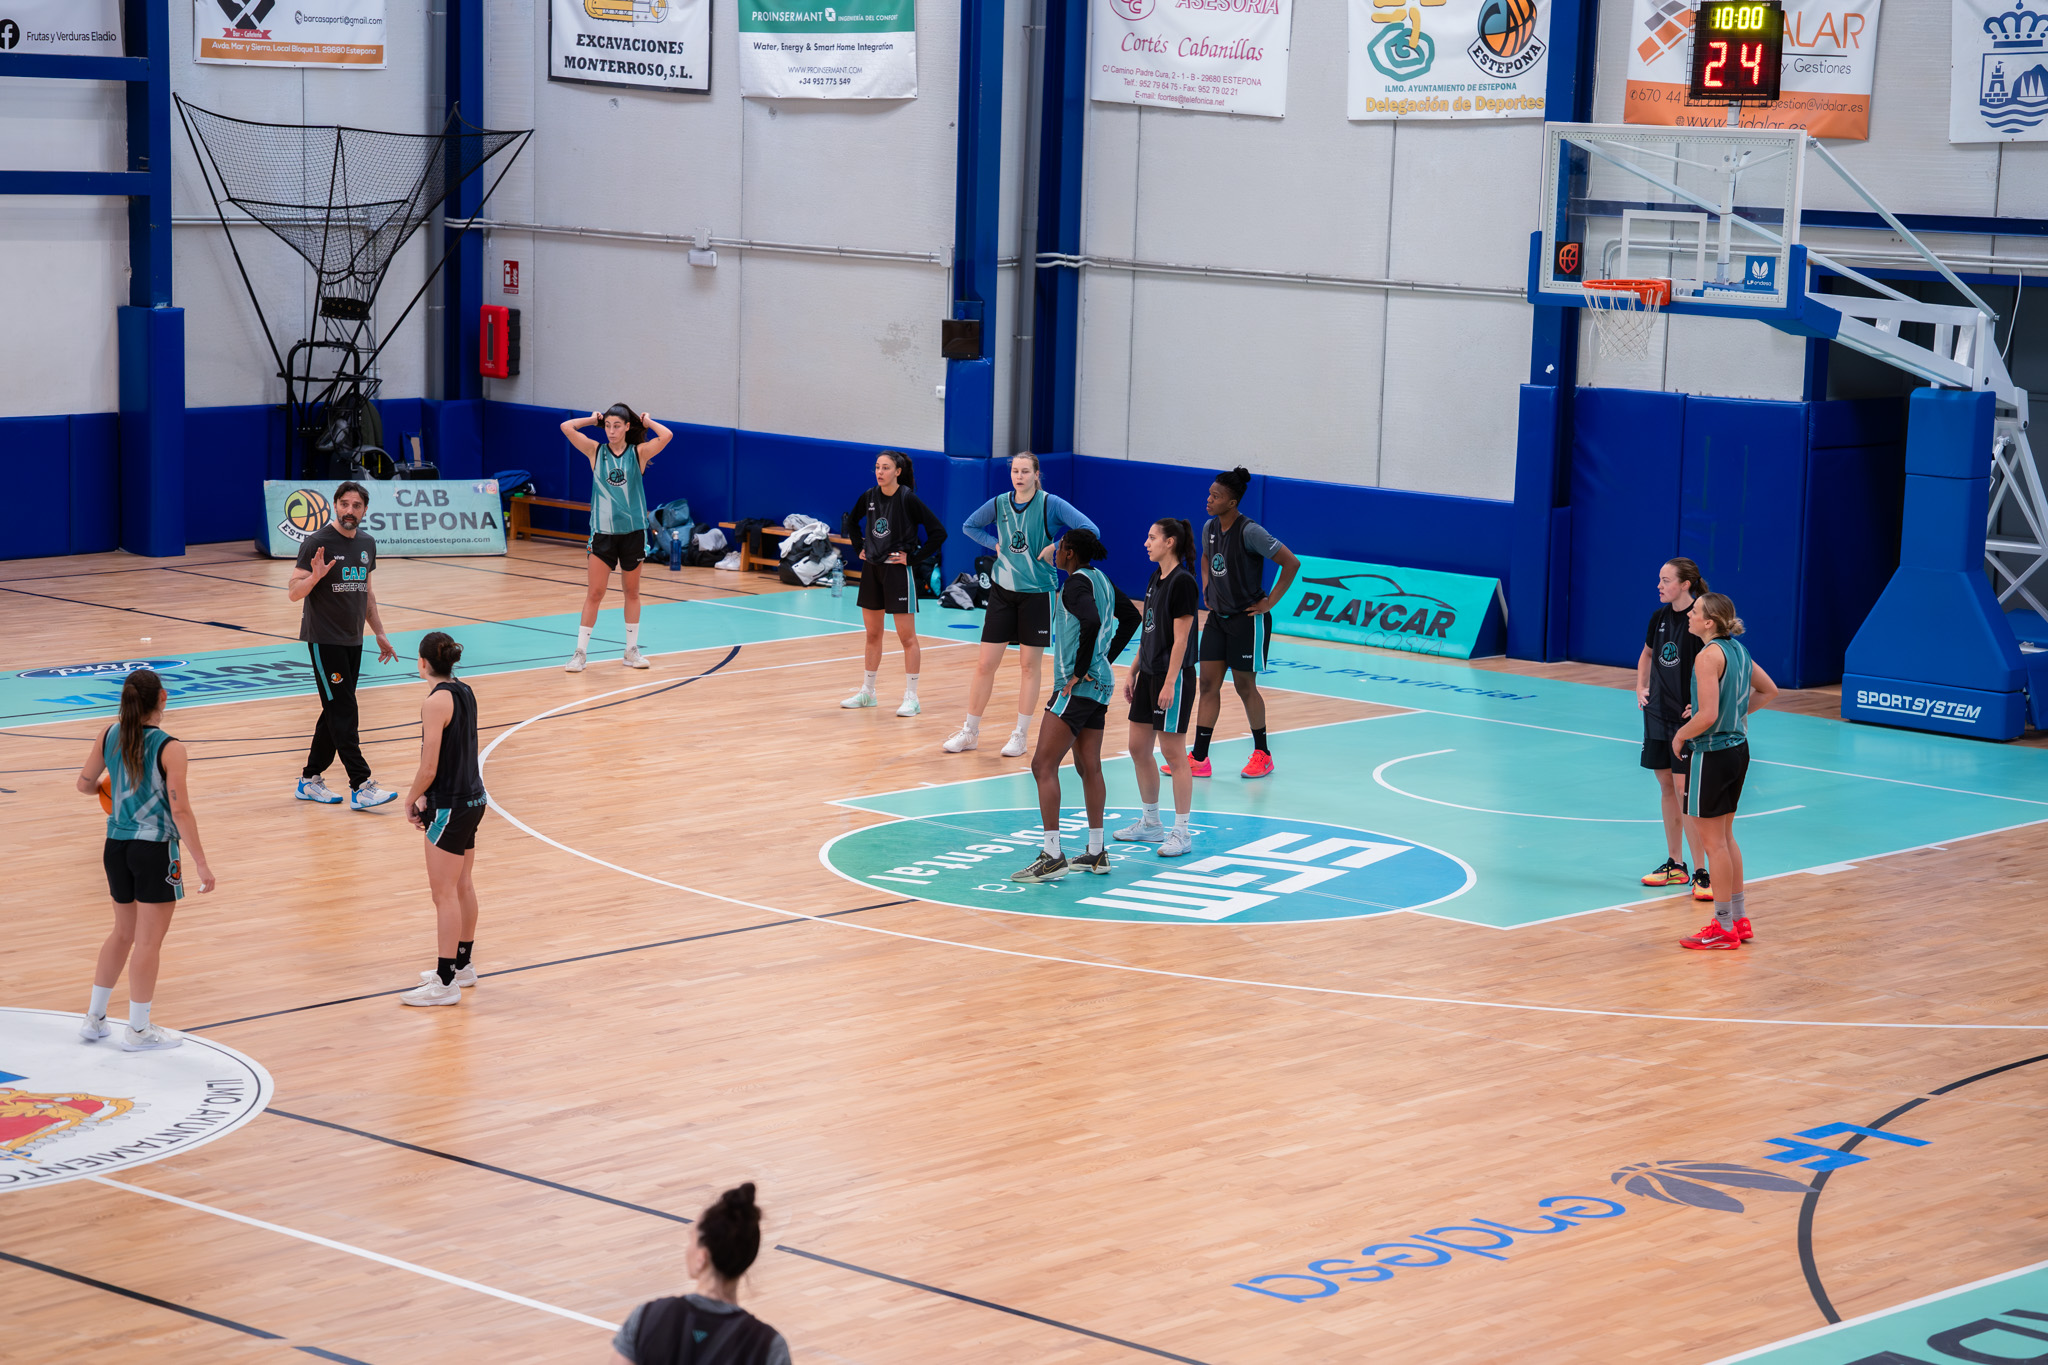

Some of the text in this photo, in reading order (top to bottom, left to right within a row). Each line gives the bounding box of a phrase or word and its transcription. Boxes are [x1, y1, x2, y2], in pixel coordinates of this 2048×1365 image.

[752, 11, 823, 22] PROINSERMANT
[1715, 6, 1764, 30] 10:00
[26, 31, 117, 43] Frutas y Verduras Eladio
[576, 33, 684, 55] EXCAVACIONES
[211, 41, 230, 50] Avda.
[231, 42, 244, 50] Mar
[245, 44, 250, 52] y
[251, 43, 272, 52] Sierra,
[273, 44, 290, 52] Local
[291, 45, 313, 54] Bloque
[322, 46, 345, 54] 29680
[346, 46, 376, 56] Estepona
[754, 42, 894, 53] Water, Energy & Smart Home Integration
[1121, 32, 1264, 61] Cortés Cabanillas
[564, 55, 693, 80] MONTERROSO, S.L.
[1472, 44, 1542, 74] ESTEPONA
[1704, 41, 1763, 87] 24
[1794, 58, 1851, 75] Gestiones
[787, 66, 863, 74] WWW.PROINSERMANT.COM
[1102, 64, 1110, 73] C/
[1111, 65, 1134, 75] Camino
[1135, 67, 1154, 77] Padre
[1155, 69, 1170, 80] Cura,
[1172, 71, 1176, 79] 2
[1190, 73, 1195, 81] B
[1201, 74, 1221, 84] 29680
[1222, 76, 1262, 87] ESTEPONA
[812, 77, 824, 85] 952
[839, 77, 851, 85] 549
[1139, 79, 1151, 88] 952
[1152, 81, 1161, 89] 79
[1161, 81, 1169, 90] 64
[1170, 82, 1178, 91] 75
[1183, 83, 1197, 92] Fax:
[1198, 85, 1210, 94] 952
[1212, 86, 1220, 94] 79
[1221, 86, 1230, 95] 02
[1230, 87, 1238, 96] 21
[1384, 82, 1517, 93] ILMO. AYUNTAMIENTO DE ESTEPONA
[1135, 90, 1156, 100] E-mail:
[1638, 88, 1661, 103] 670
[1666, 90, 1681, 104] 44
[1366, 94, 1545, 115] Delegación de Deportes
[1687, 113, 1807, 130] wwwidalares
[395, 489, 450, 507] CAB
[358, 511, 498, 531] ESTEPONA
[375, 536, 491, 545] ww.baloncestoestepona.com
[342, 566, 367, 581] CAB
[331, 582, 368, 593] ESTEPON
[1293, 592, 1456, 638] PLAYCAR
[1364, 630, 1444, 656] COSTA
[1857, 690, 1982, 719] SPORTSYSTEM
[1231, 1194, 1626, 1304] endesa
